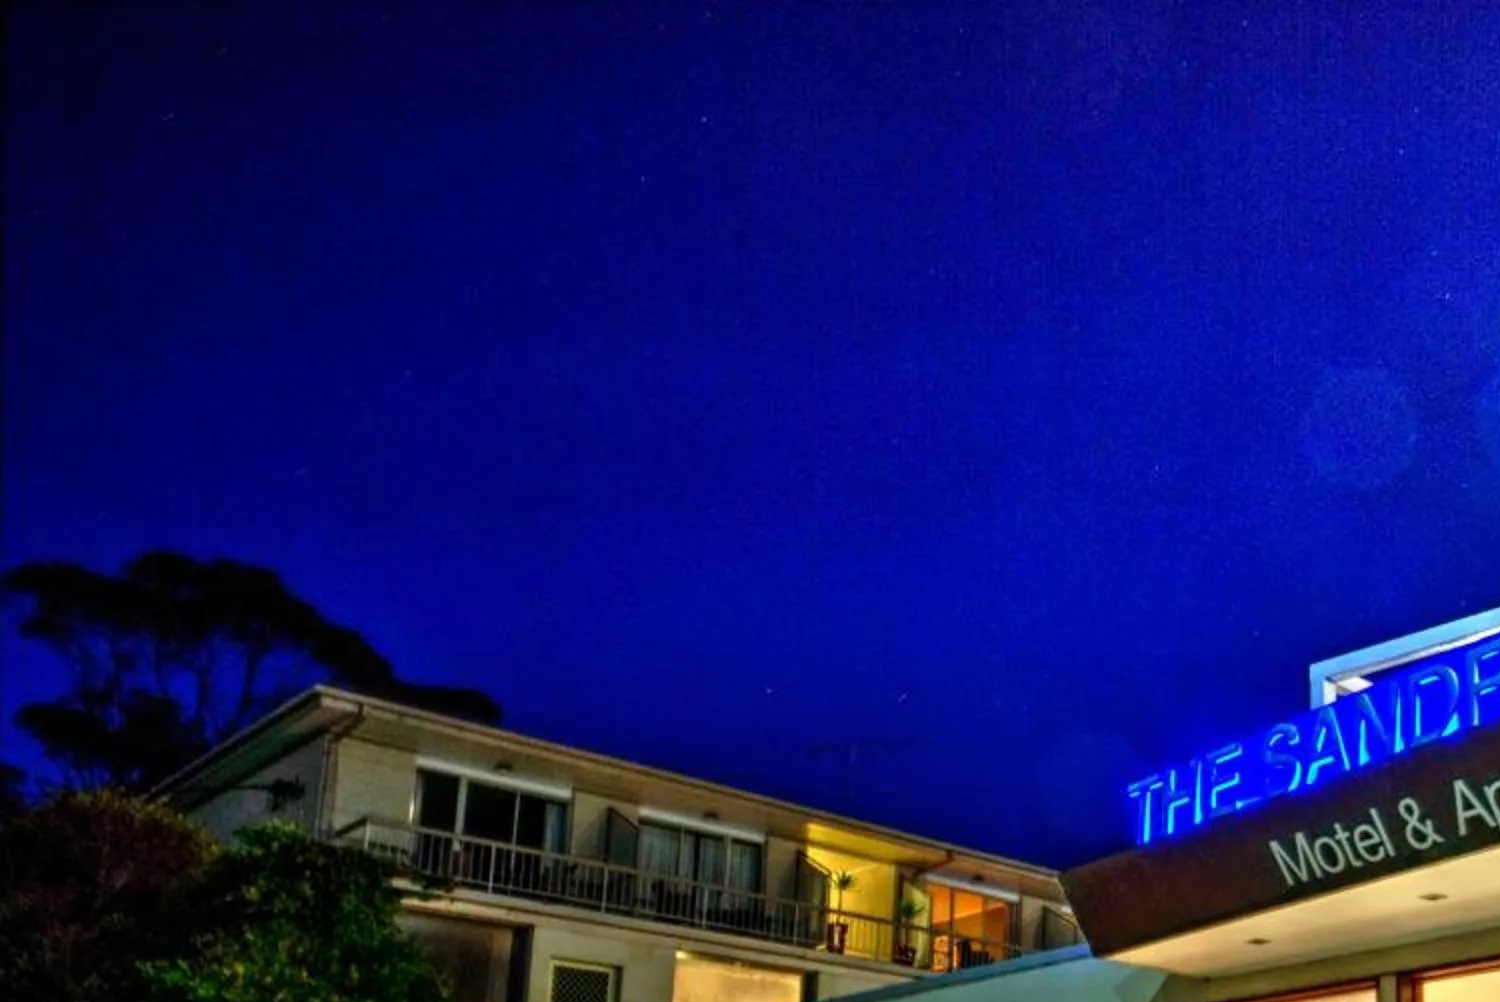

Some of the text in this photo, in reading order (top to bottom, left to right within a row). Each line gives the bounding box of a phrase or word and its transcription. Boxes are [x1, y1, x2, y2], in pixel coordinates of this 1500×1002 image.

[1127, 741, 1259, 846] THE
[1268, 807, 1396, 887] Motel
[1397, 797, 1446, 851] &
